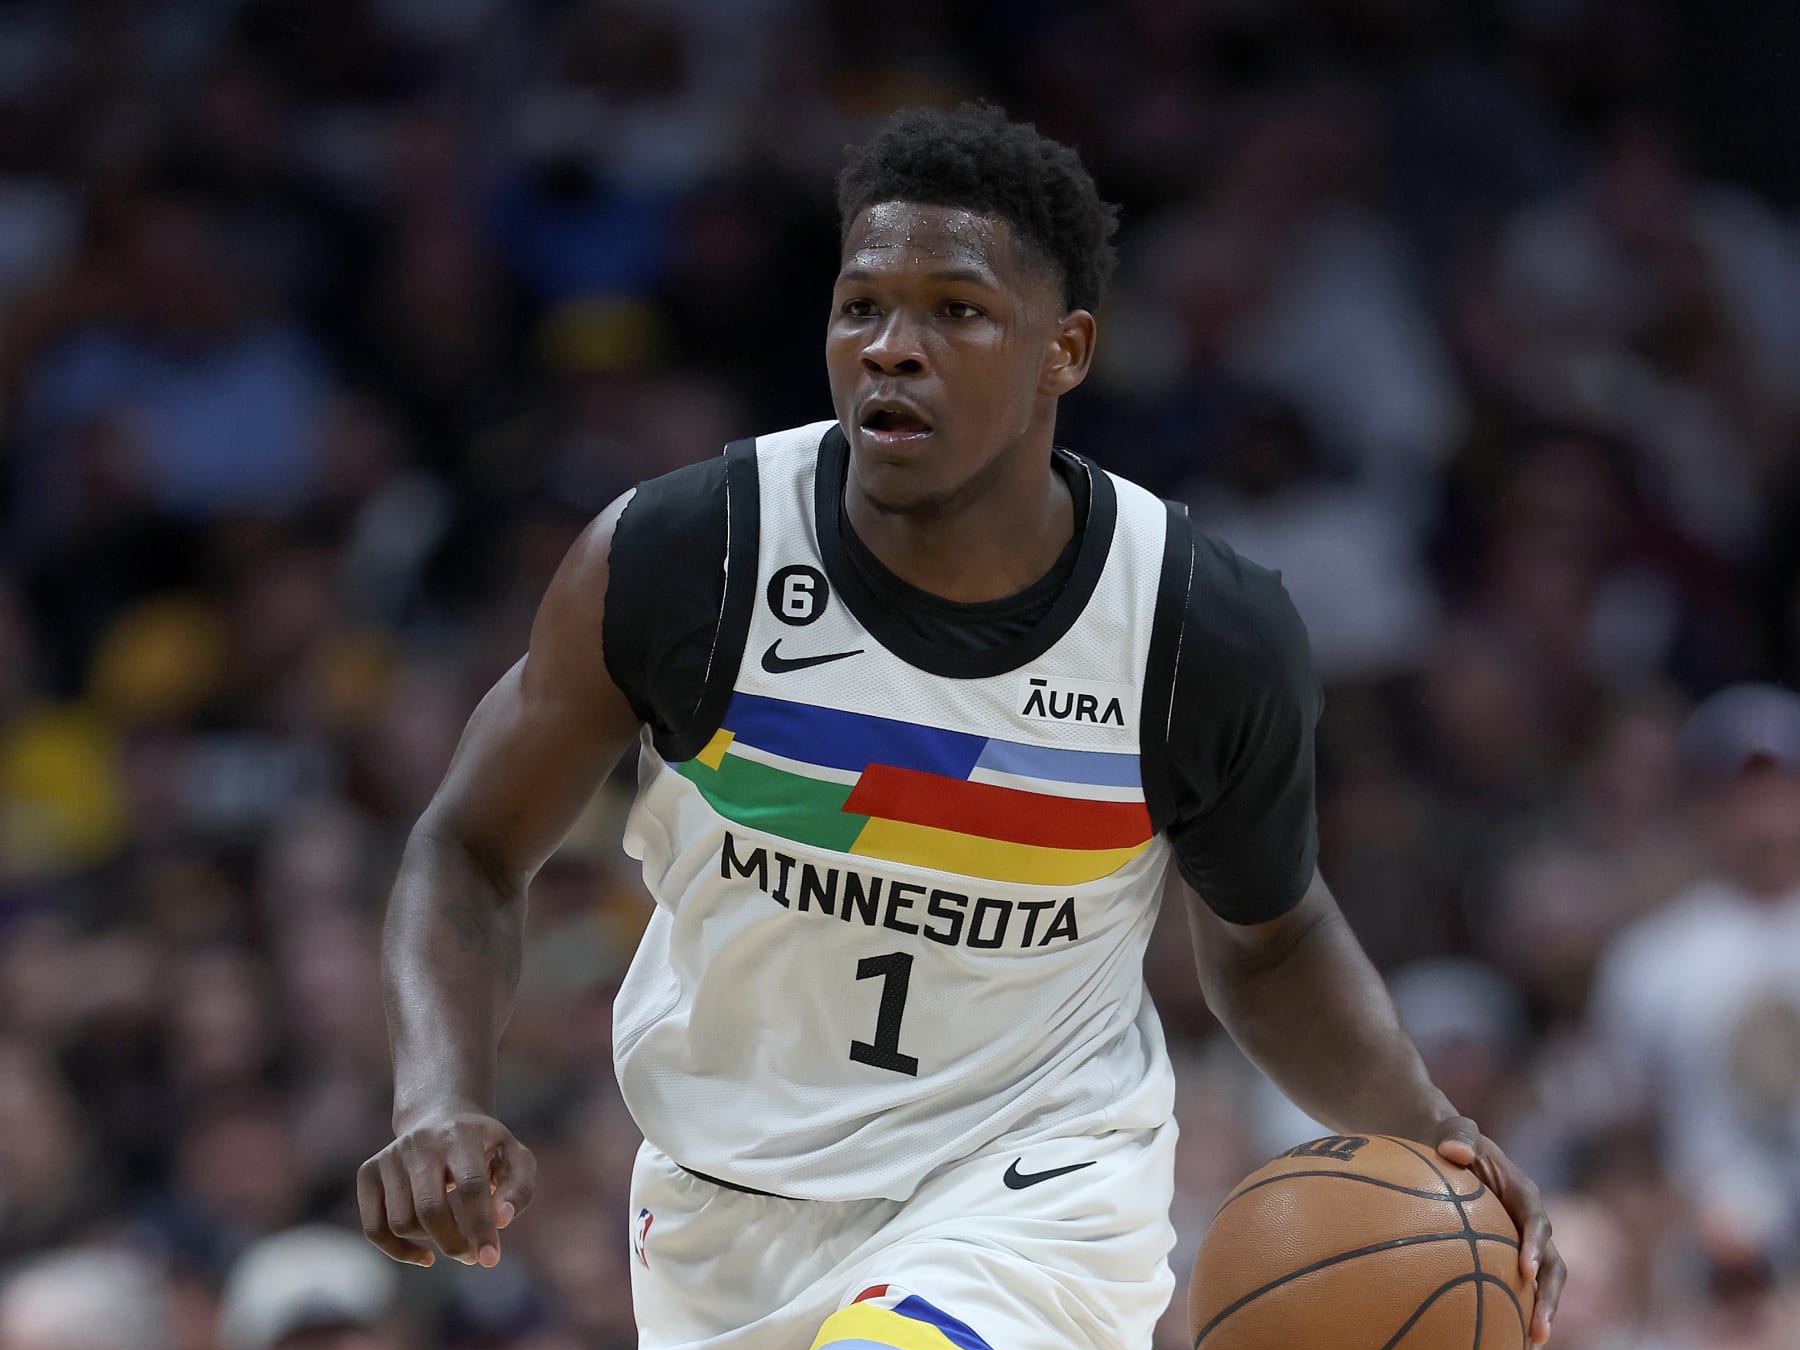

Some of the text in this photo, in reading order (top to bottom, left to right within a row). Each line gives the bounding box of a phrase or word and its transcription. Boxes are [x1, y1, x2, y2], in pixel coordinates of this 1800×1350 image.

[782, 574, 815, 618] 6
[721, 831, 1078, 949] MINNESOTA
[850, 951, 918, 1077] 1
